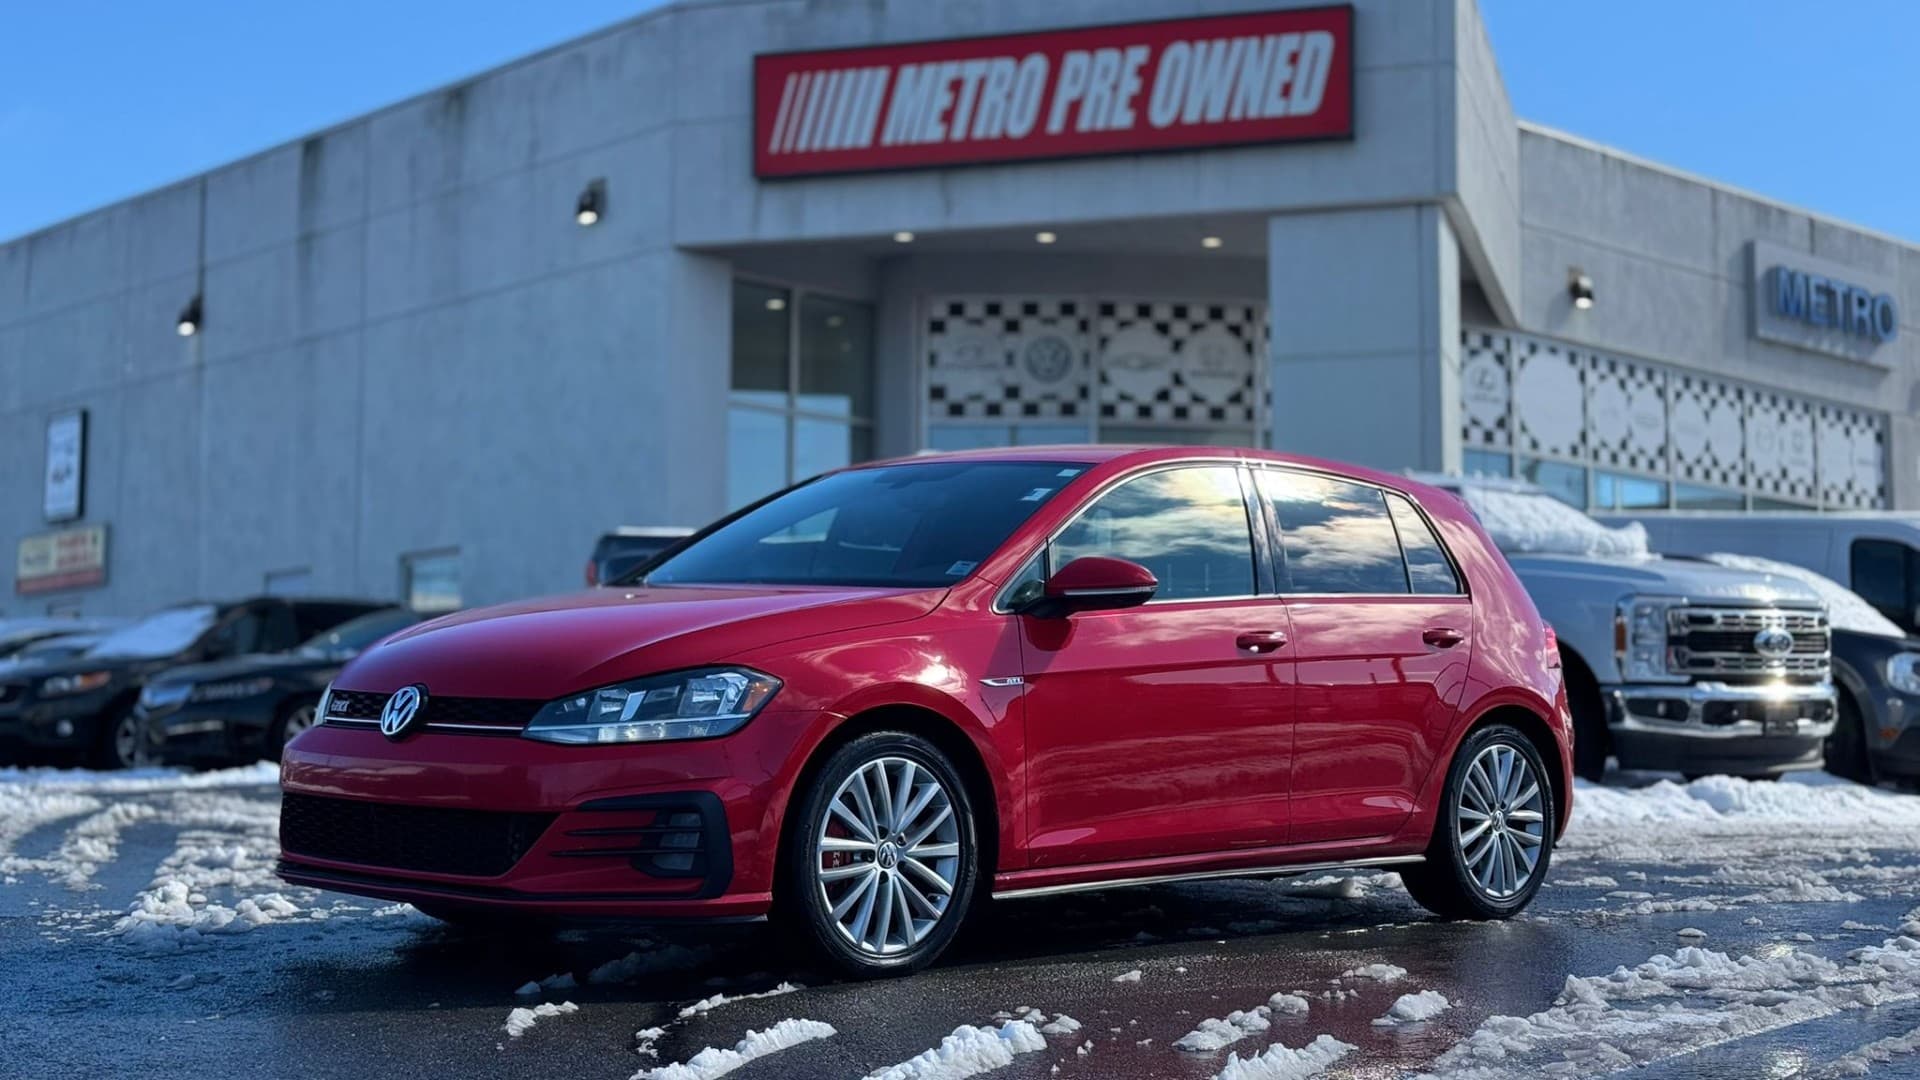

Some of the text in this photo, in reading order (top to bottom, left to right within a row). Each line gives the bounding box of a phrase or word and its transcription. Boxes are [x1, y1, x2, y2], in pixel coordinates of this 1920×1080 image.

[881, 31, 1335, 147] METRO PRE OWNED
[1775, 264, 1899, 342] METRO
